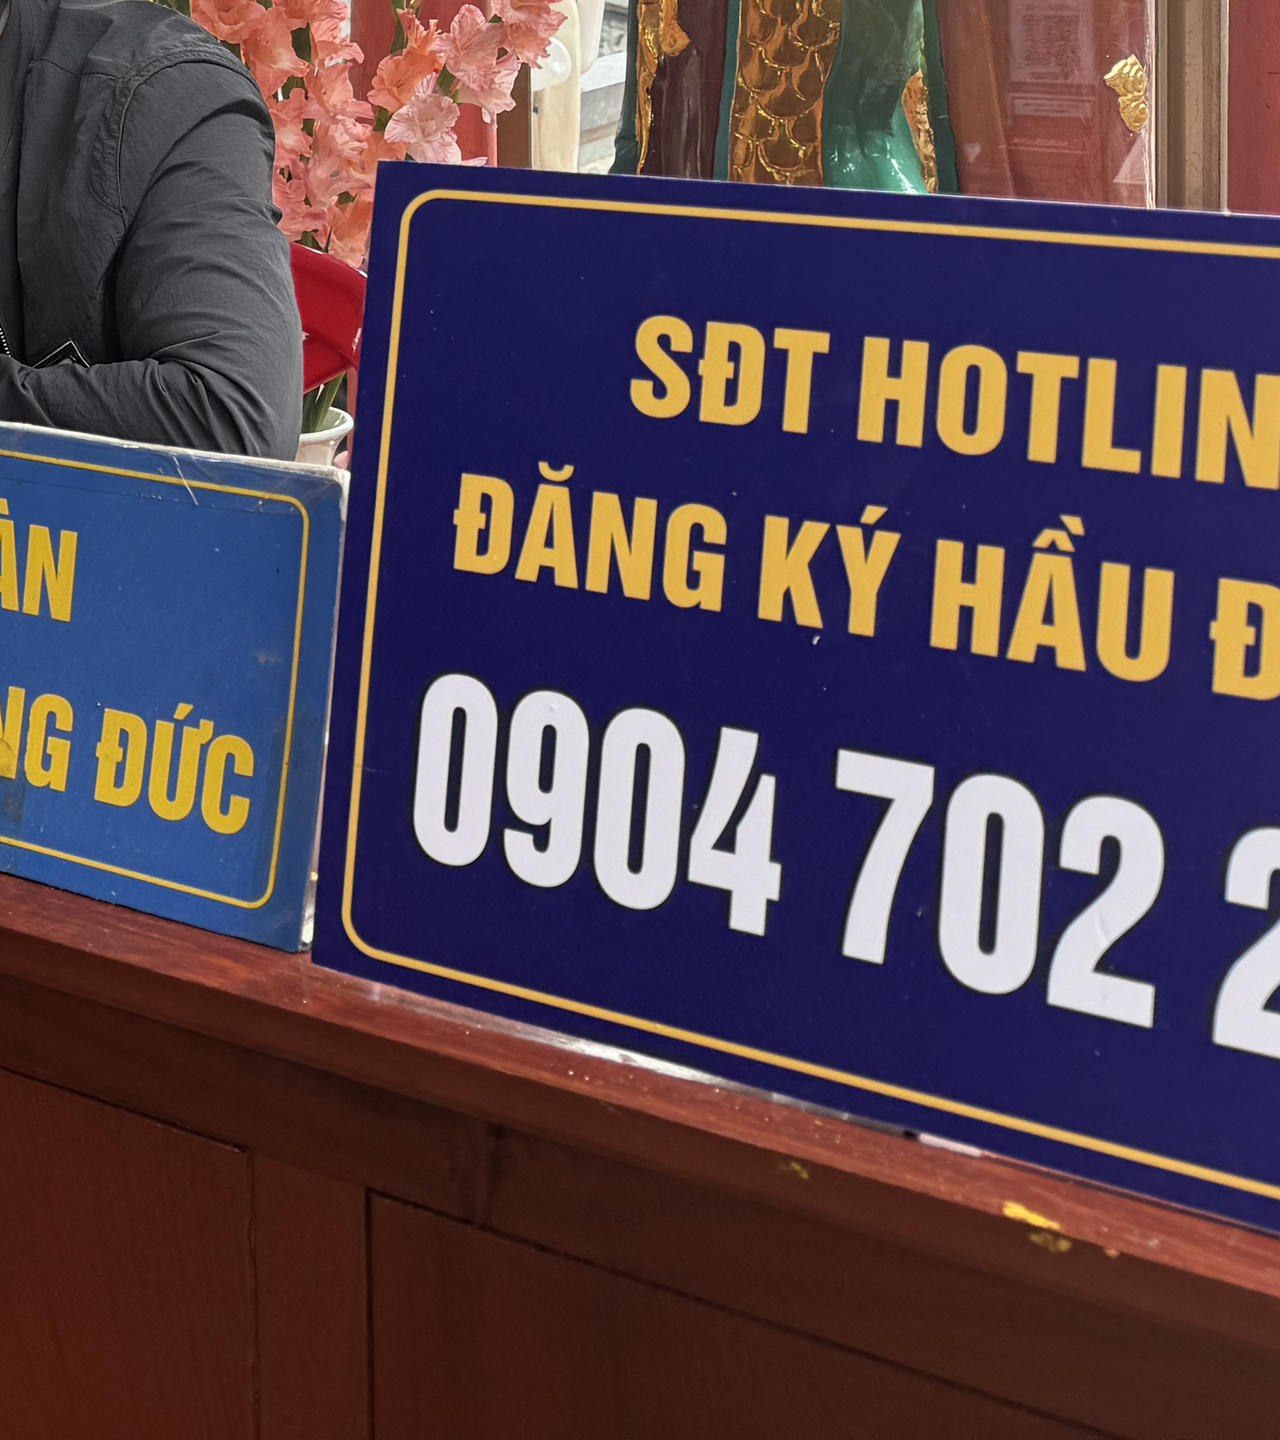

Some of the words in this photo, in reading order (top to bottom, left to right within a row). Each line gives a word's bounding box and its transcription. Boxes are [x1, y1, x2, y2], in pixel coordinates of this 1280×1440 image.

[631, 314, 830, 435] SĐT
[856, 336, 1280, 491] HOTLIN
[452, 461, 728, 612] ĐĂNG
[757, 505, 900, 638] KÝ
[930, 514, 1174, 684] HẦU
[94, 703, 255, 835] ĐỨC
[413, 672, 783, 937] 0904
[835, 749, 1165, 1029] 702
